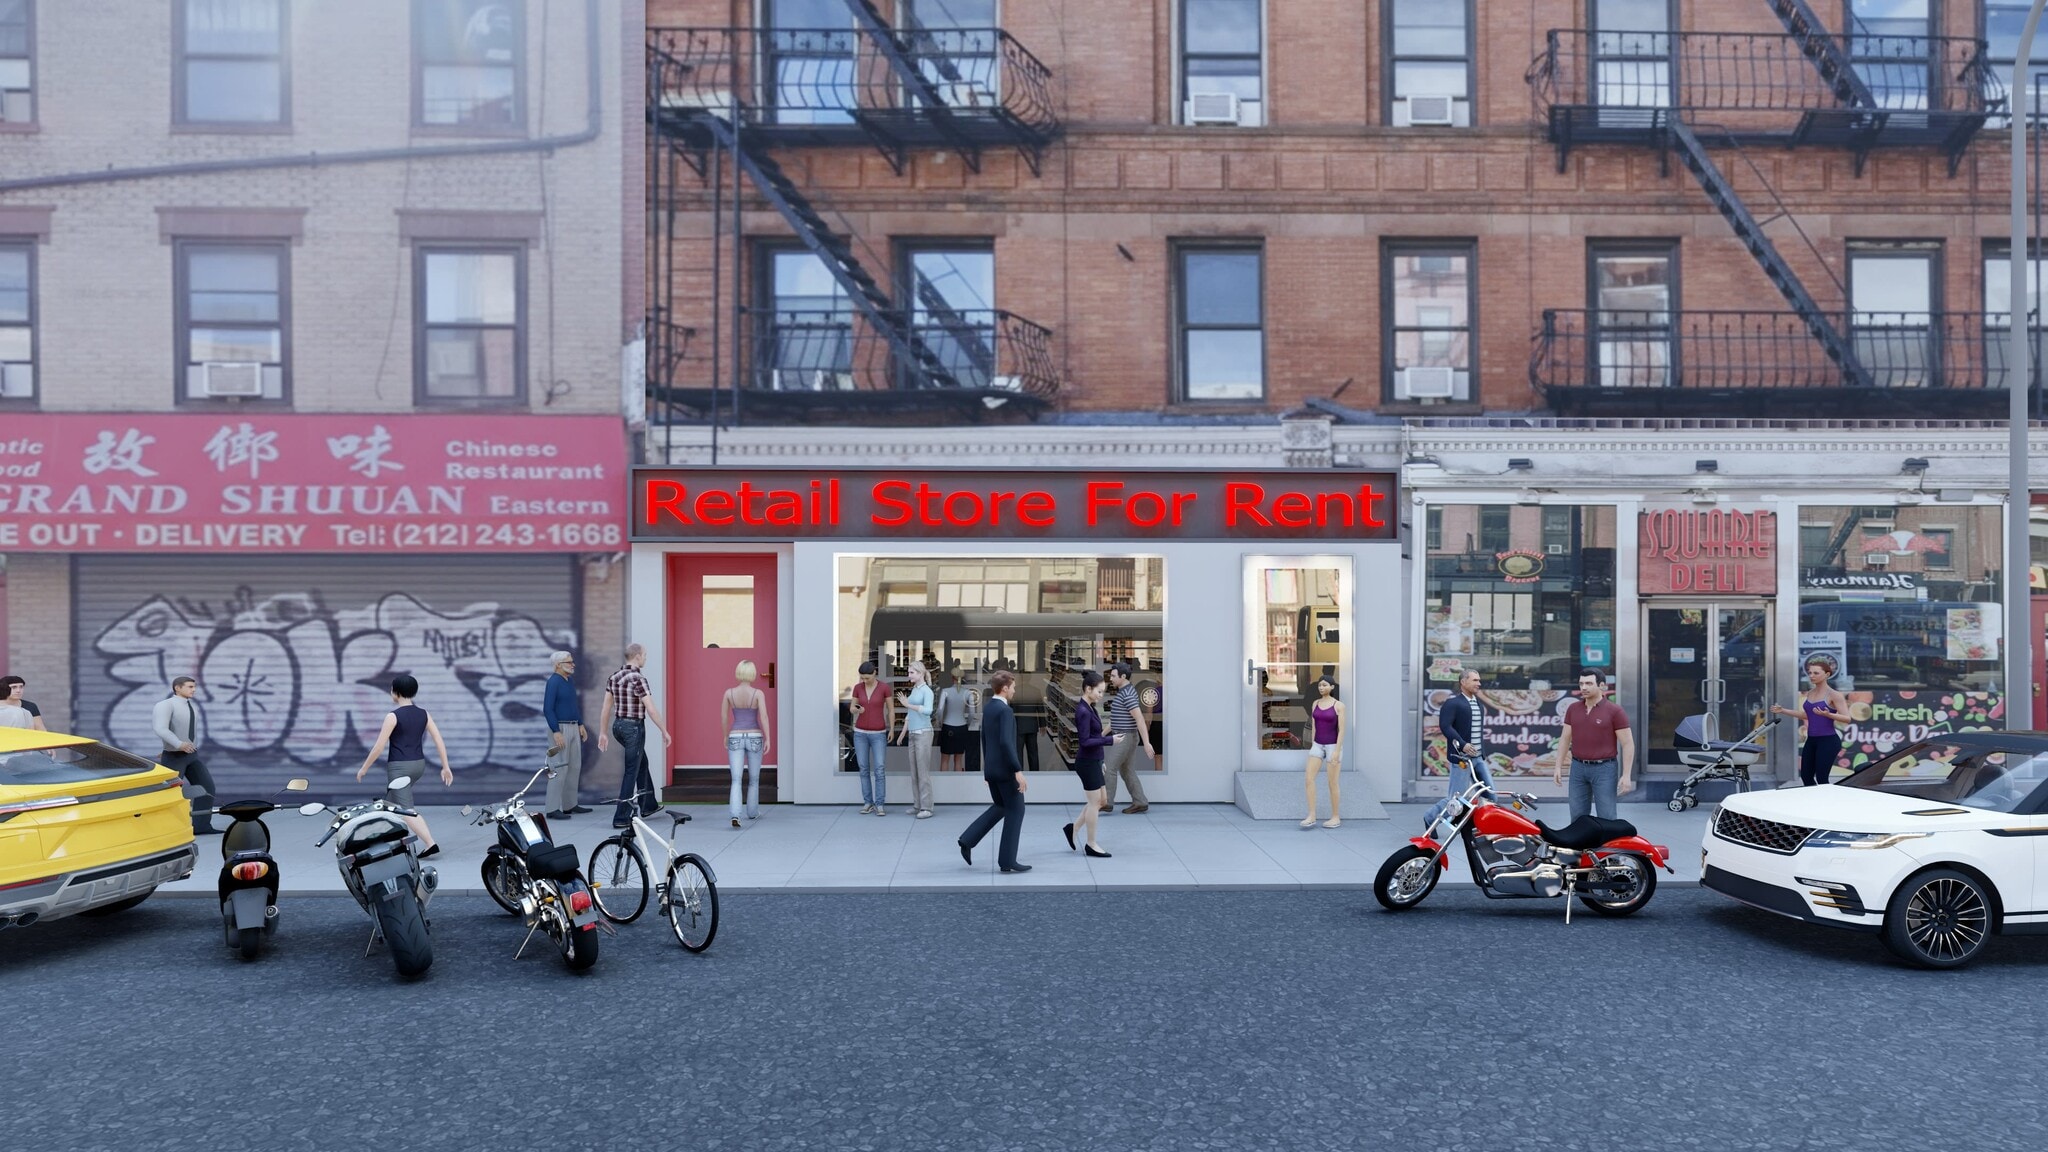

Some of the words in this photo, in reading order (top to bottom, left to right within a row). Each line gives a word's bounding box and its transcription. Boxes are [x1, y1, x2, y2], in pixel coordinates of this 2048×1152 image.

[446, 439, 558, 457] Chinese
[446, 462, 604, 480] Restaurant
[221, 485, 465, 514] SHUUAN
[490, 496, 609, 514] Eastern
[646, 479, 840, 526] Retail
[871, 480, 1056, 526] Store
[1087, 481, 1197, 527] For
[1225, 482, 1385, 527] Rent
[29, 524, 101, 545] OUT
[136, 524, 307, 545] DELIVERY
[475, 523, 621, 546] 243-1668
[1646, 508, 1770, 562] SQUARE
[1670, 563, 1745, 592] DELI
[1872, 704, 1934, 721] Fresh
[1843, 723, 1906, 744] Juice
